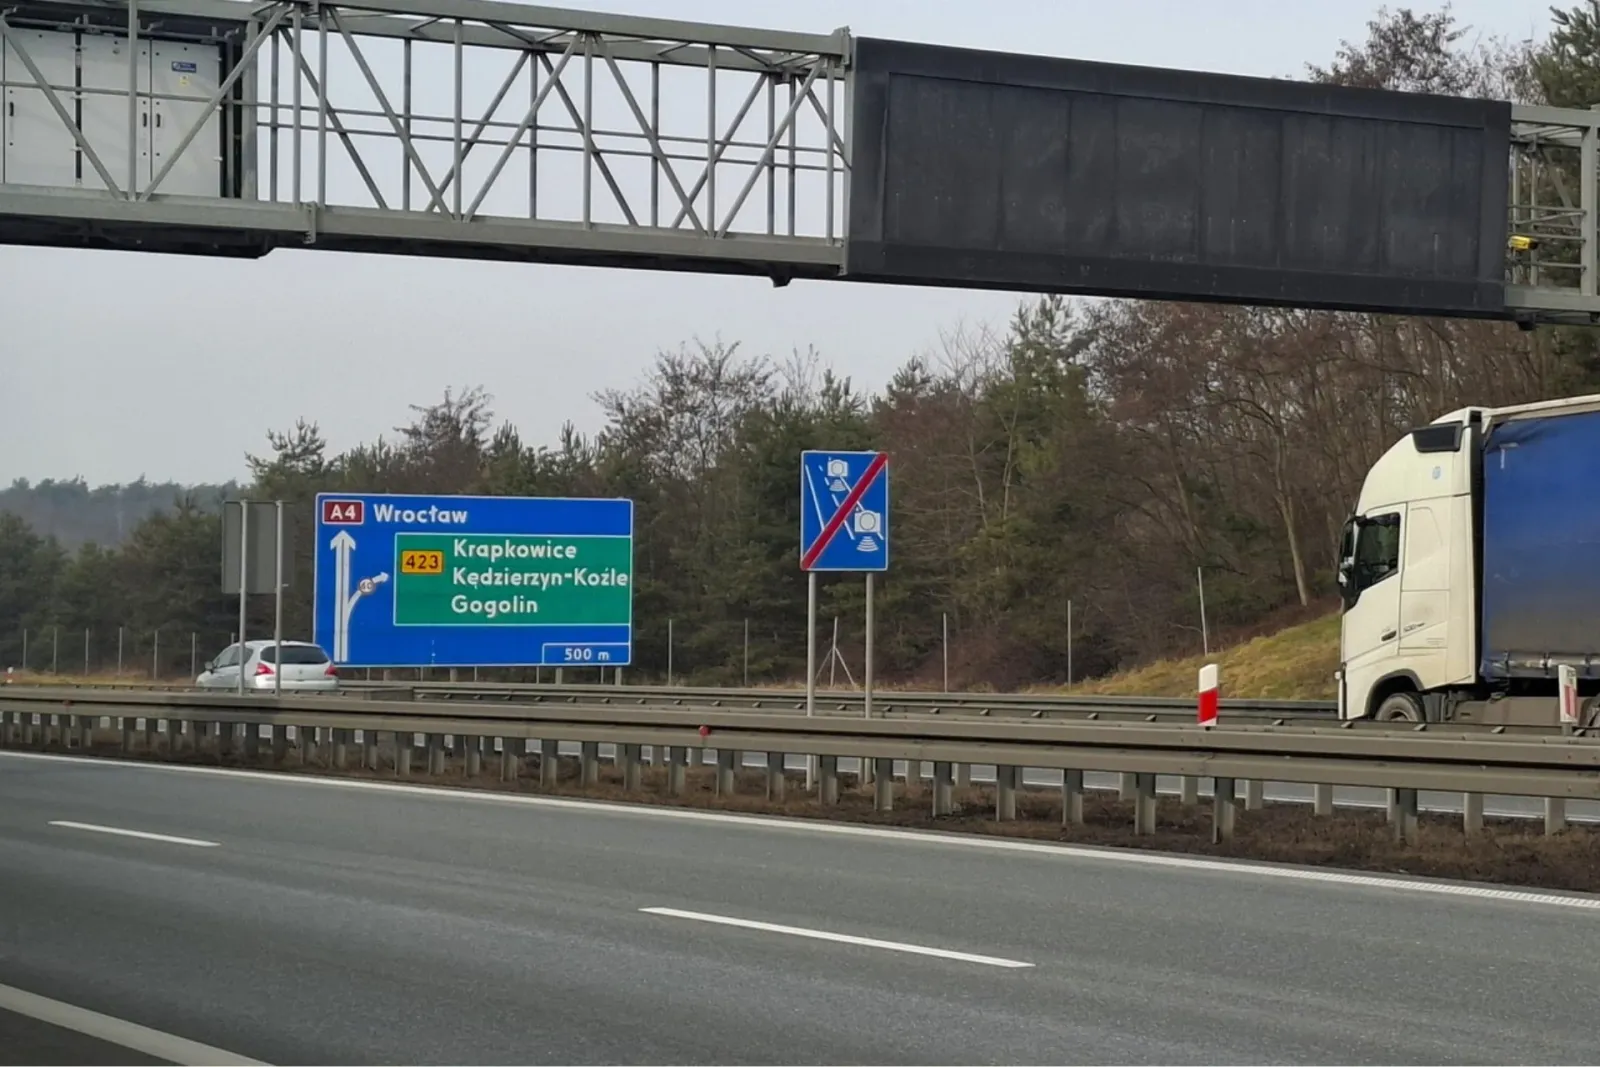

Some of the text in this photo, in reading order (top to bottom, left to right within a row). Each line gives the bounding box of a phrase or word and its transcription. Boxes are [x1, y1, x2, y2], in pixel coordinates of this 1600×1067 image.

[330, 504, 356, 520] A4
[373, 503, 468, 523] Wrocław
[454, 538, 577, 563] Krapkowice
[405, 554, 439, 569] 423
[453, 567, 628, 591] Kędzierzyn-Koźle
[451, 595, 538, 618] Gogolin
[564, 648, 610, 661] 500 m
